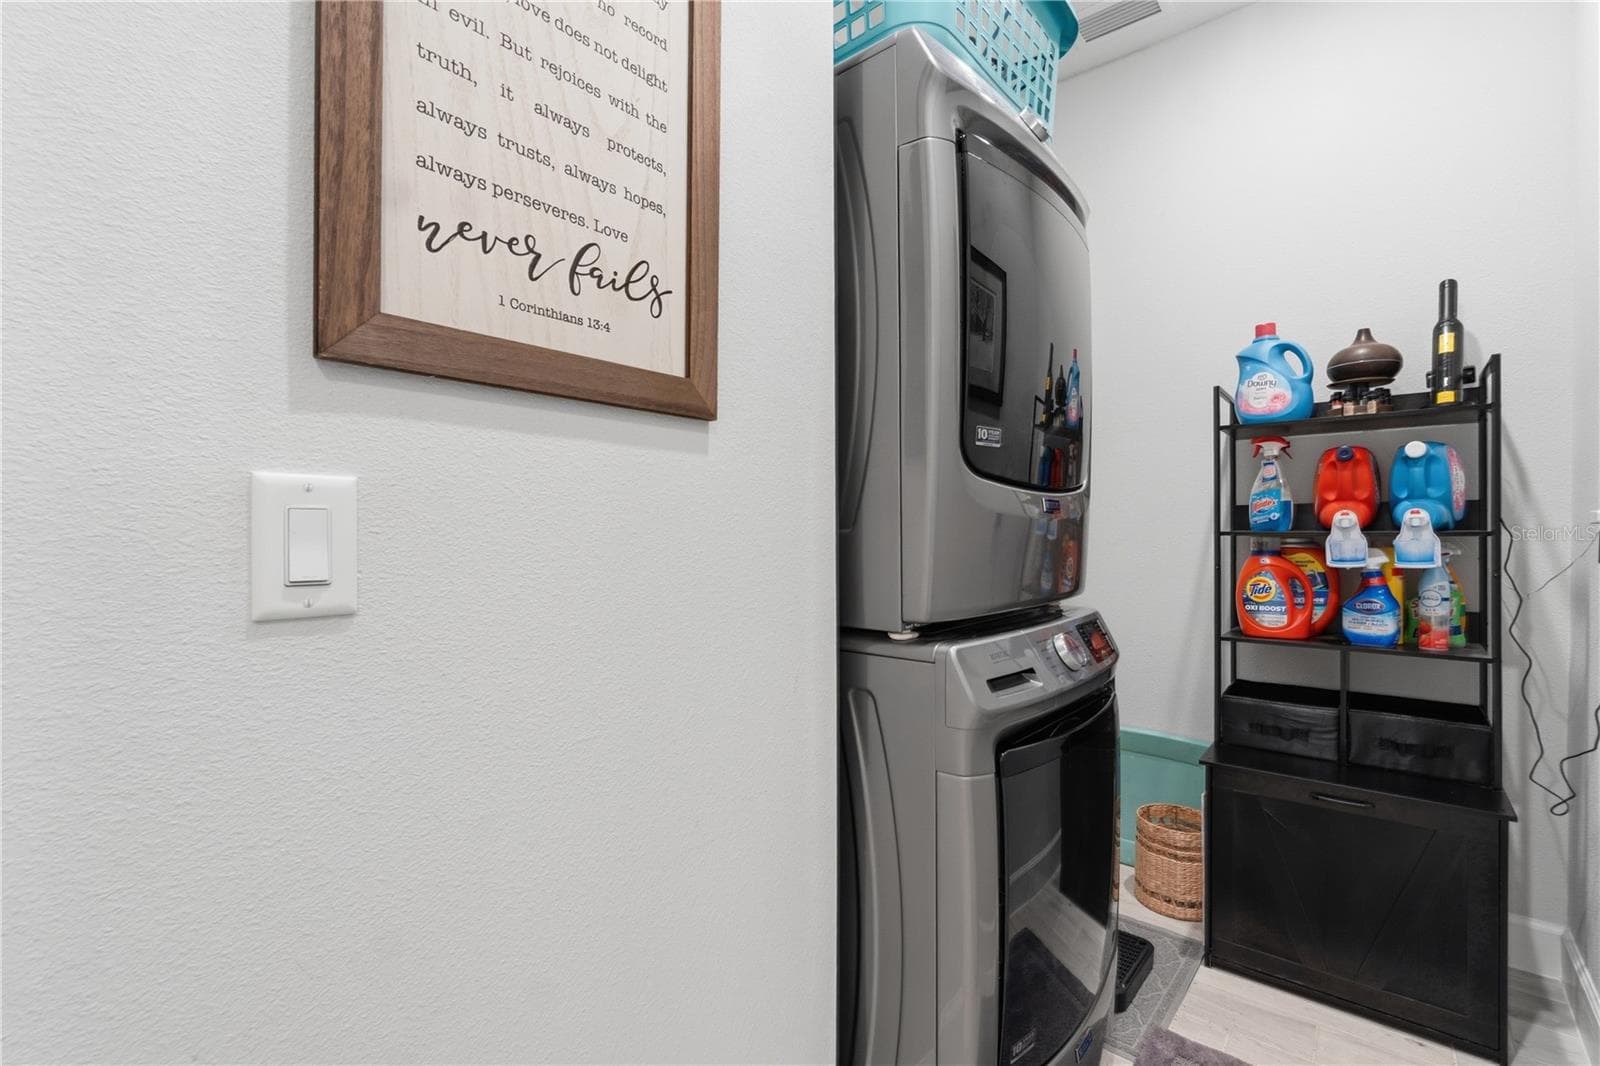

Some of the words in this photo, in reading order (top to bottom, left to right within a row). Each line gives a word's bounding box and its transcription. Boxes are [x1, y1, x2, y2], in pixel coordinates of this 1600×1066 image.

[449, 8, 490, 39] evil.
[500, 32, 532, 61] But
[540, 56, 601, 98] rejoices
[608, 93, 640, 119] with
[646, 113, 667, 133] the
[554, 18, 590, 47] does
[594, 40, 618, 63] not
[621, 57, 668, 93] delight
[624, 14, 668, 52] record
[416, 42, 478, 87] truth,
[500, 84, 514, 101] it
[534, 102, 590, 138] always
[607, 137, 667, 177] protects,
[416, 100, 487, 140] always
[497, 132, 556, 171] trusts,
[564, 163, 617, 195] always
[624, 187, 666, 217] hopes,
[416, 155, 487, 191] always
[492, 182, 589, 229] perseveres.
[594, 219, 629, 243] Love
[418, 215, 565, 281] never
[569, 243, 673, 318] fails
[498, 295, 505, 307] 1
[510, 298, 583, 326] Corinthians
[587, 318, 611, 333] 13:4
[1247, 380, 1277, 389] Downy
[978, 428, 988, 440] 10
[1250, 583, 1272, 596] Tide
